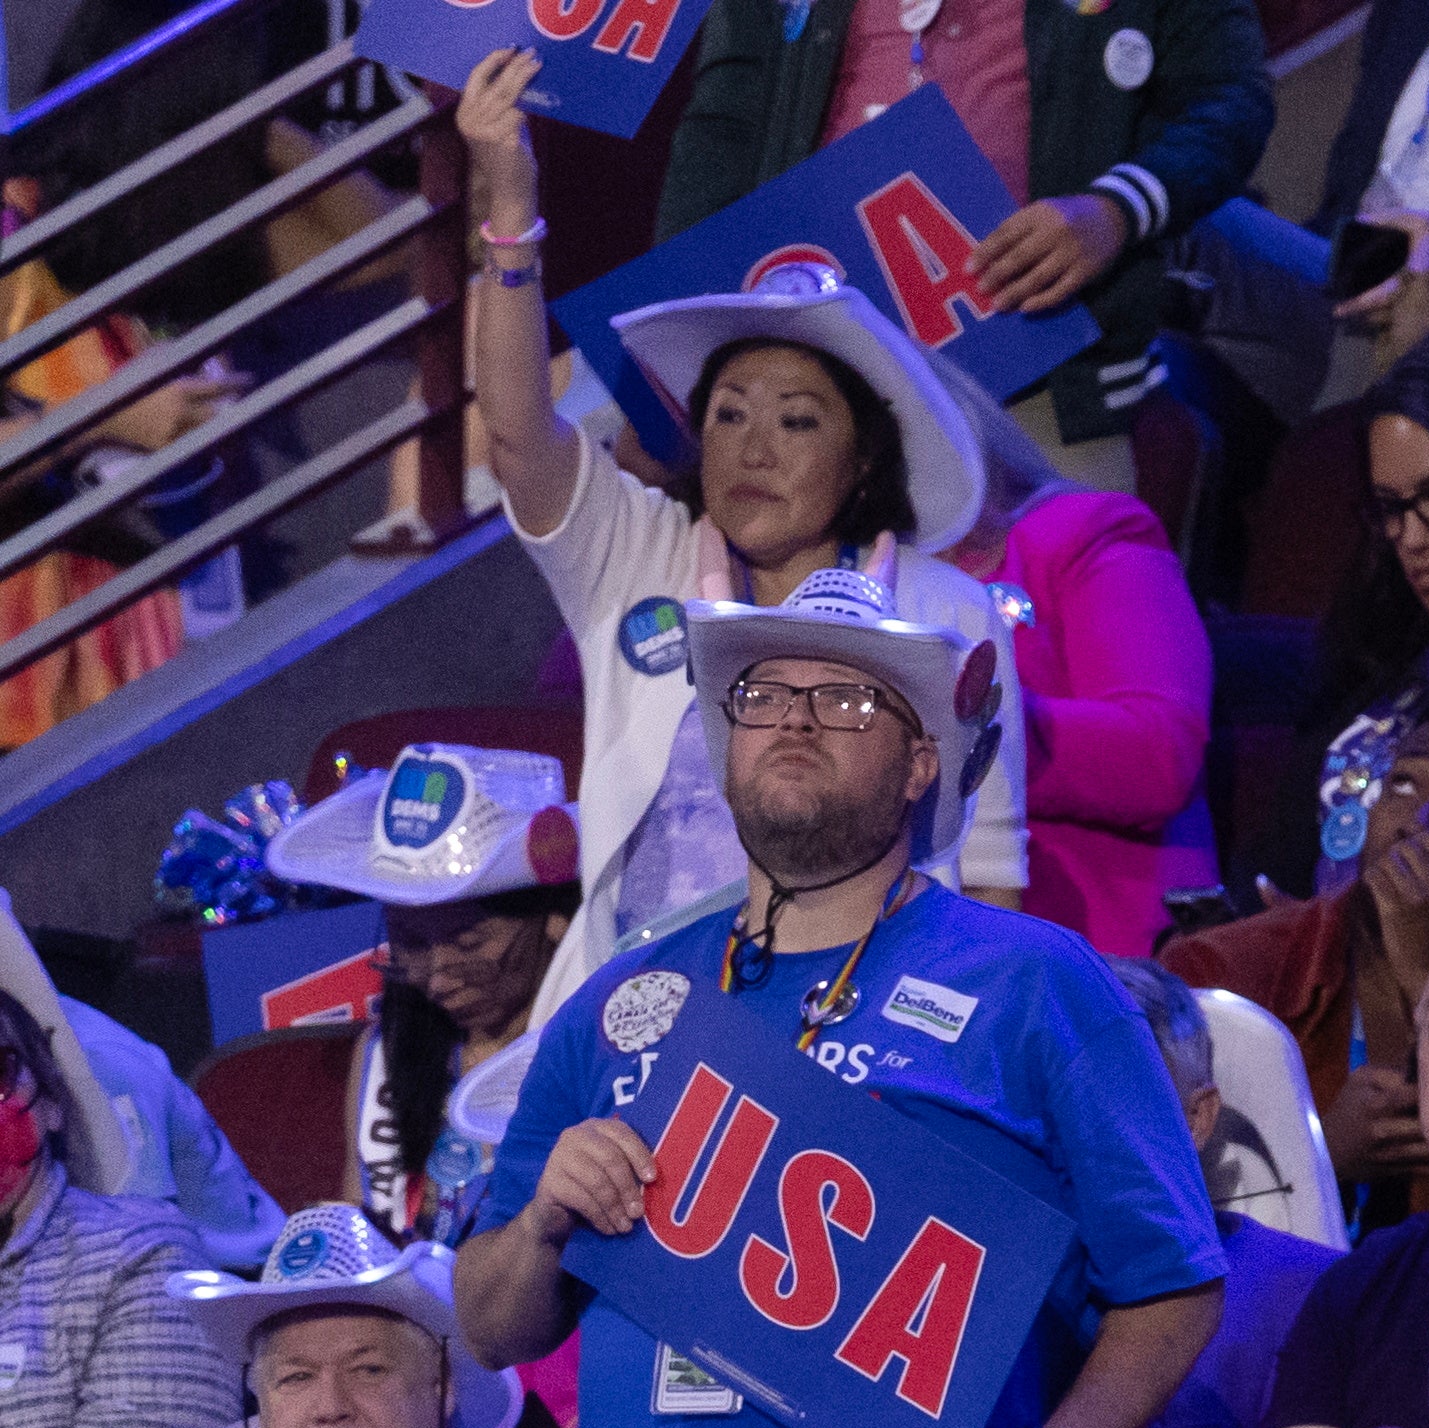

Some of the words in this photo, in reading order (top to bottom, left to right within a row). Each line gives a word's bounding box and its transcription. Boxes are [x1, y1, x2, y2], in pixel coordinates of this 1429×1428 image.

[893, 992, 964, 1025] DelBene
[874, 1050, 913, 1072] for
[644, 1061, 987, 1420] USA
